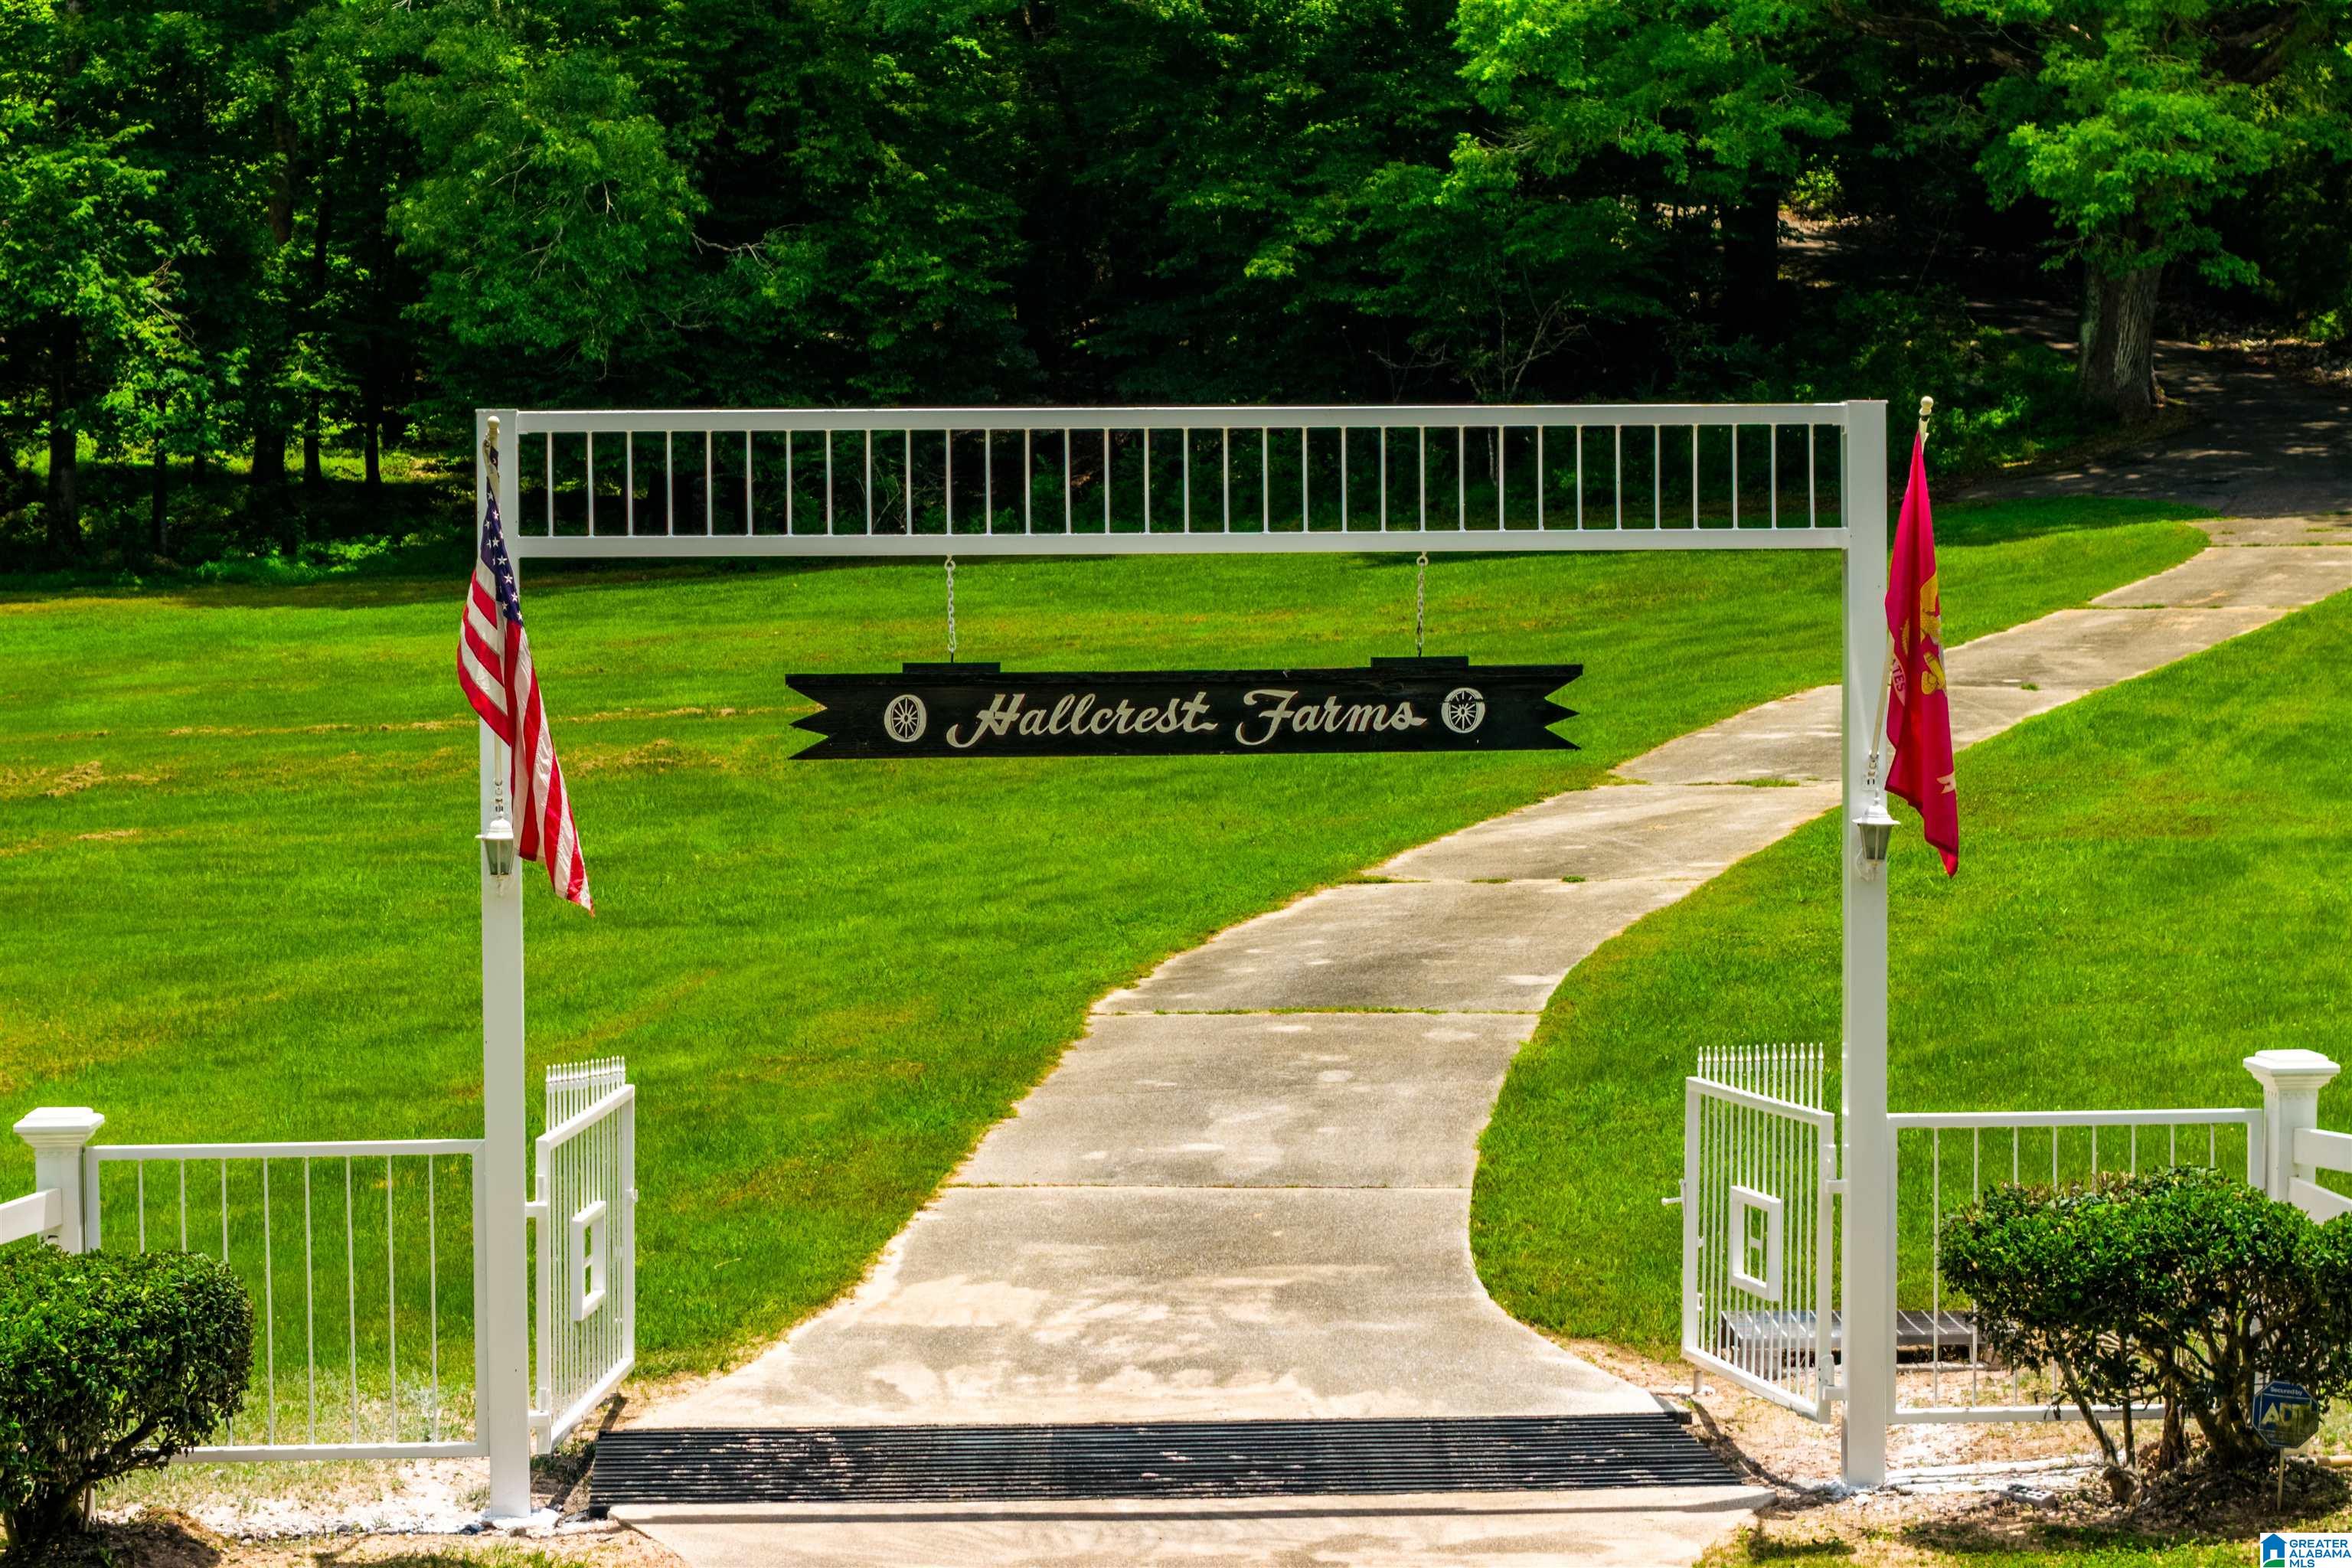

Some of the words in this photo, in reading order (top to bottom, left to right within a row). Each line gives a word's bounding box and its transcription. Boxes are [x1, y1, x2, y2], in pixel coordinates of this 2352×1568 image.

[946, 691, 1219, 748] Hallcrest
[1235, 688, 1428, 746] Farms
[2260, 1402, 2311, 1426] ADT
